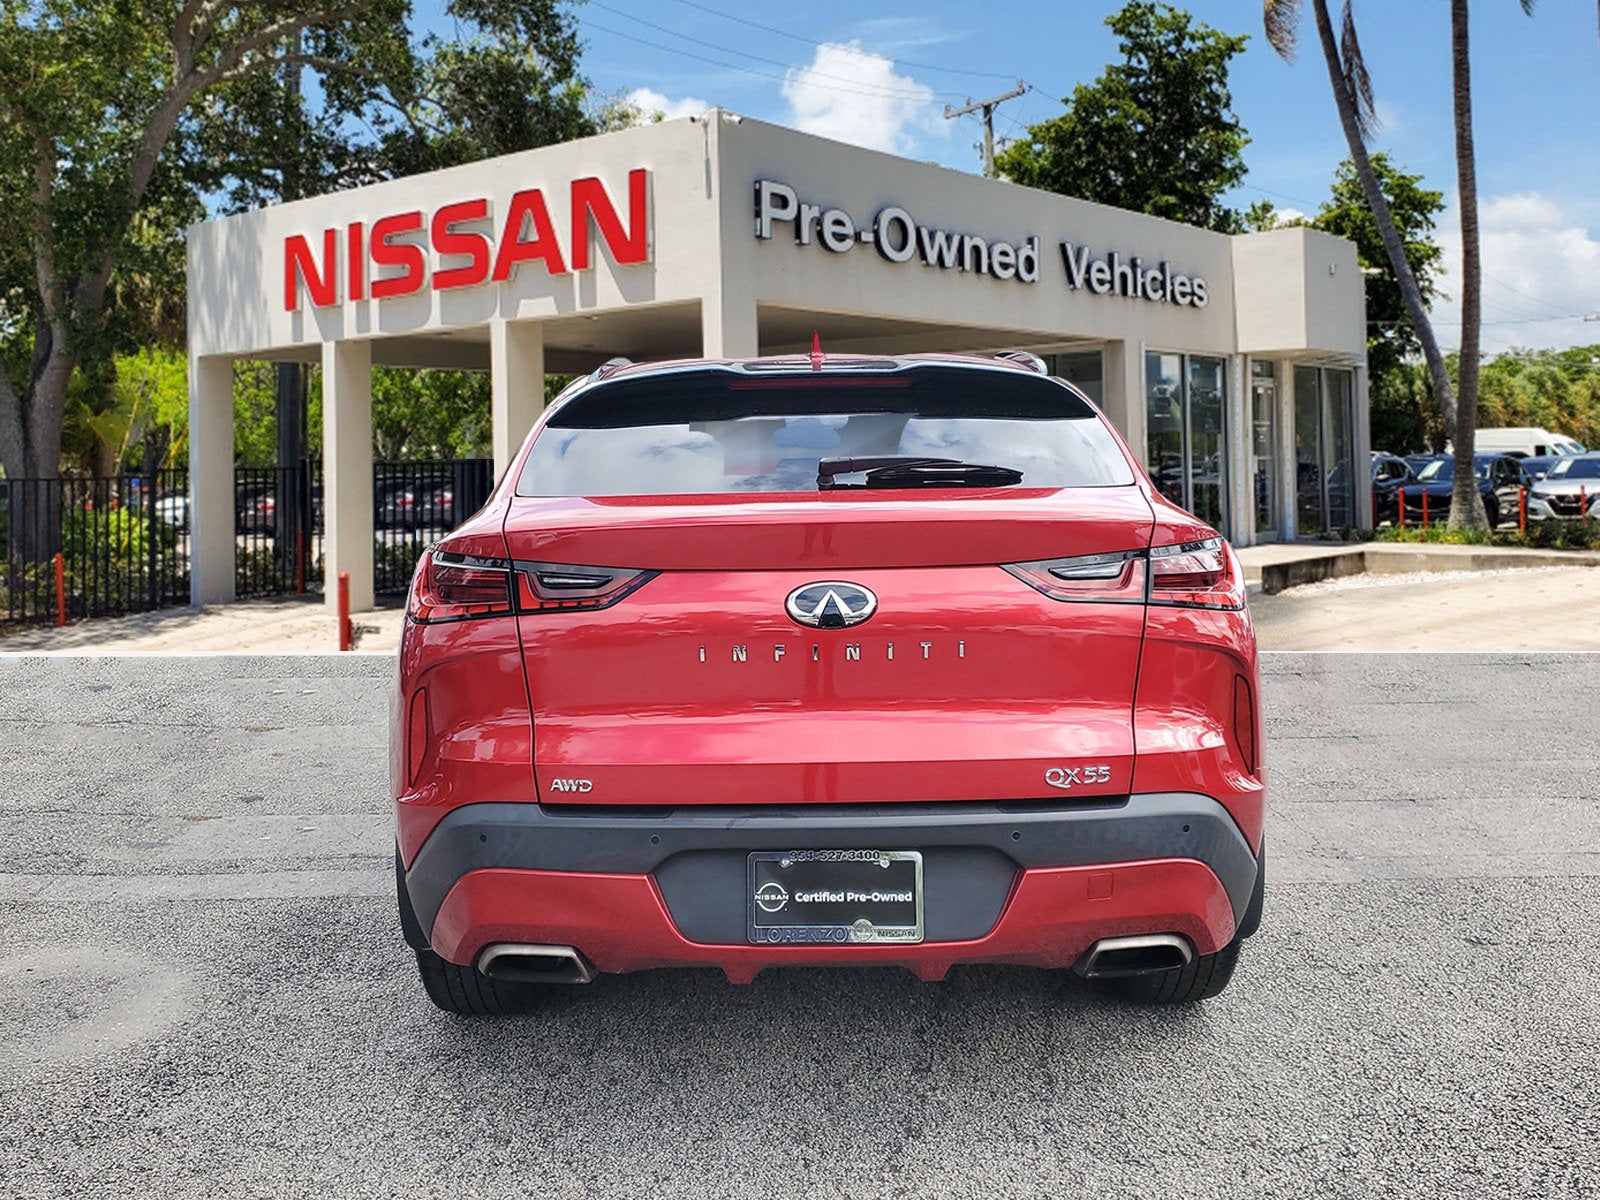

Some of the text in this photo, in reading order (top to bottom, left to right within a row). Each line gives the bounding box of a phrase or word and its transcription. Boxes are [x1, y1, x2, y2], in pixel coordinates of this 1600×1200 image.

[285, 168, 648, 311] NISSAN
[754, 179, 1210, 308] Pre-Owned Vehicles
[1044, 765, 1112, 790] QX55
[549, 778, 594, 793] AWD
[795, 892, 912, 902] Certified Pre-Owned
[756, 928, 847, 942] LORENZO
[877, 930, 916, 938] NISSAN
